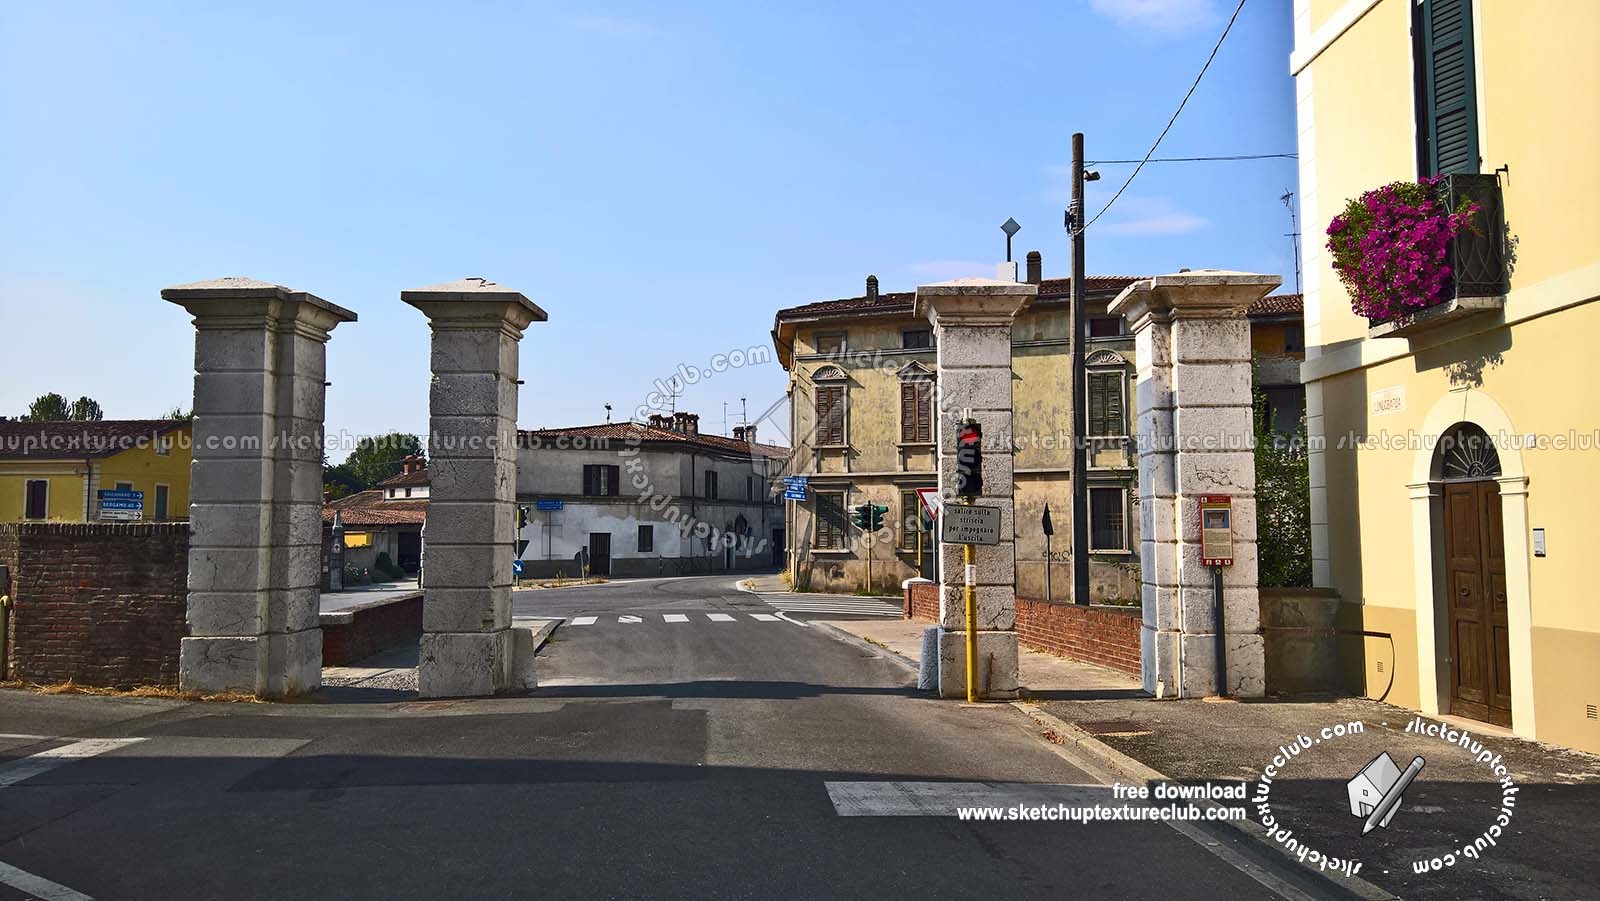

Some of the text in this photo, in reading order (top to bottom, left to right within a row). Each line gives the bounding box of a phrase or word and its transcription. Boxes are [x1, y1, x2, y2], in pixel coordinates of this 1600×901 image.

[953, 507, 991, 516] salire sulla
[961, 526, 994, 534] impegnare
